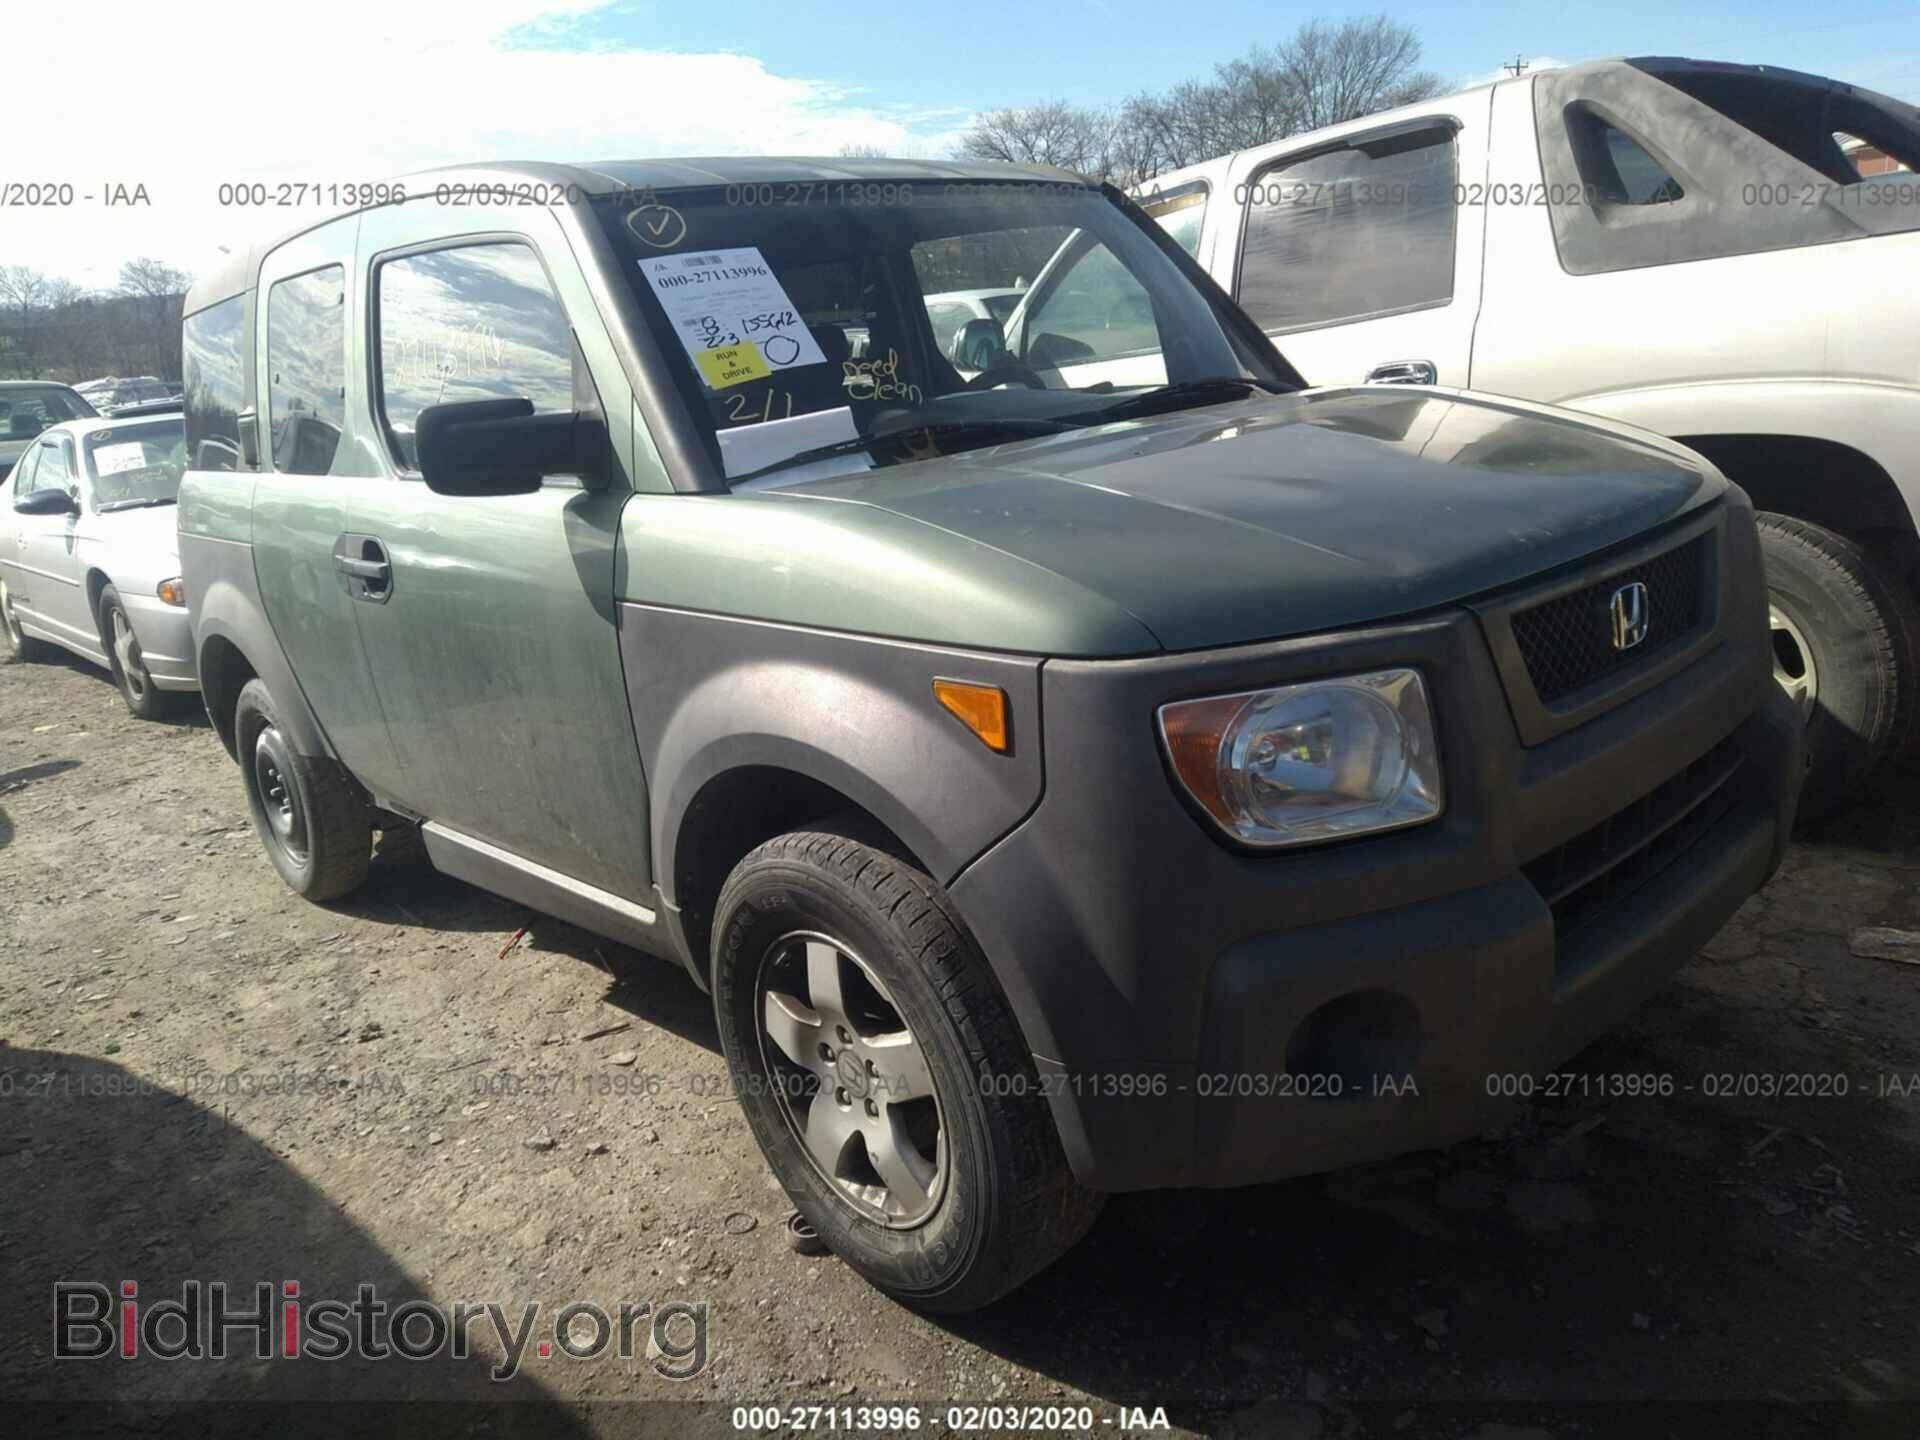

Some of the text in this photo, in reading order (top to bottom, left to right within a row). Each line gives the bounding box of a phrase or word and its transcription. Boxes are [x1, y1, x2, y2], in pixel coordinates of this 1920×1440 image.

[658, 266, 767, 289] 000-27113996
[716, 350, 738, 361] RUN
[722, 366, 753, 381] DRIVE
